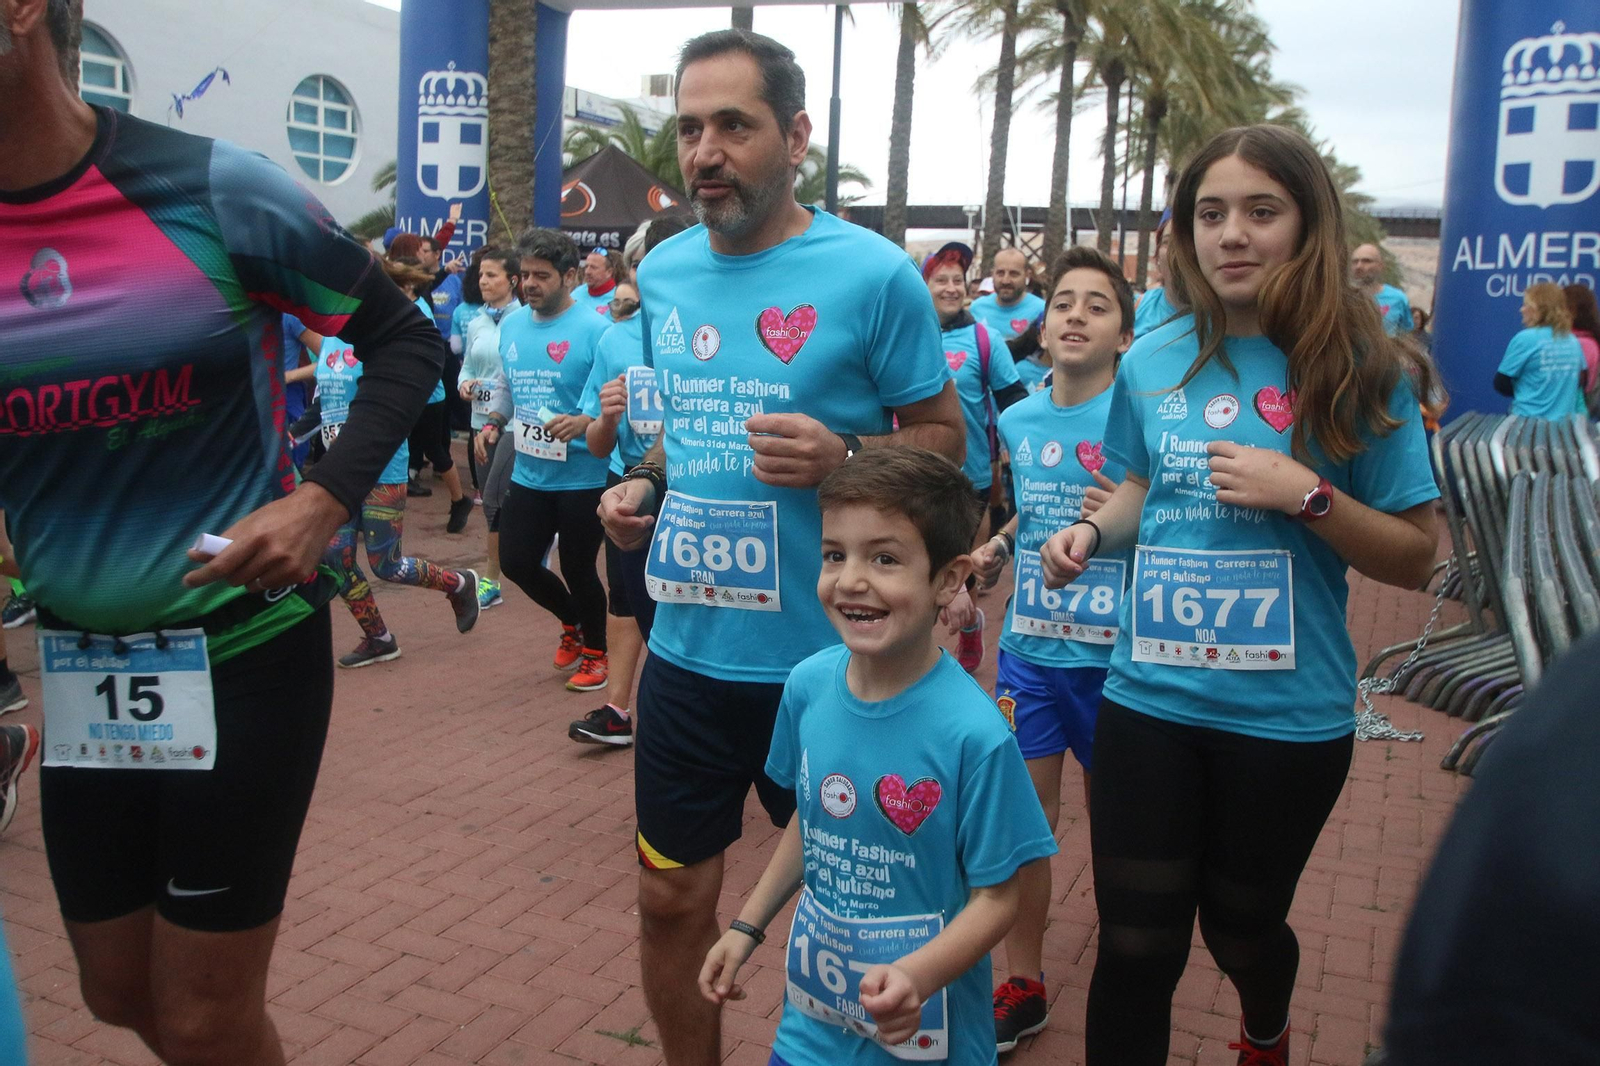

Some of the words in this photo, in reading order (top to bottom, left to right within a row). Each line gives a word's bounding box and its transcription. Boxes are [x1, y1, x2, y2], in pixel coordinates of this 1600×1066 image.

[656, 333, 685, 347] ALTEA
[663, 369, 670, 395] I
[672, 374, 725, 394] Runner
[730, 376, 790, 400] Fashion
[671, 396, 730, 414] Carrera
[1156, 403, 1187, 414] ALTEA
[522, 422, 556, 443] 739
[673, 417, 690, 432] por
[693, 416, 707, 434] el
[711, 416, 750, 436] autis
[1159, 431, 1169, 453] I
[687, 452, 721, 478] nada
[720, 450, 740, 472] te
[1163, 453, 1210, 470] Carre
[1024, 478, 1058, 492] Runner
[1060, 481, 1085, 496] Fashi
[1162, 472, 1182, 484] por
[1186, 471, 1200, 487] el
[1021, 490, 1061, 504] Carrera
[1063, 496, 1083, 507] azul
[708, 507, 745, 519] Carrera
[747, 510, 765, 520] azul
[1034, 504, 1046, 516] el
[1048, 505, 1082, 519] autism
[1155, 508, 1183, 524] Que
[1184, 501, 1212, 522] nada
[1211, 502, 1230, 519] te
[1233, 507, 1269, 523] pare
[657, 526, 767, 574] 1680
[1150, 555, 1177, 566] Runner
[1178, 557, 1208, 569] Fashion
[1214, 559, 1256, 568] Carrera
[1259, 558, 1278, 569] azul
[690, 569, 715, 584] FRAN
[1143, 570, 1158, 579] por
[1160, 570, 1171, 580] el
[1173, 570, 1211, 584] autismo
[1022, 577, 1115, 615] 1678
[1143, 583, 1280, 628] 1677
[1195, 628, 1217, 643] NOA
[95, 674, 165, 722] 15
[88, 722, 103, 740] NO
[103, 723, 136, 740] TENGO
[137, 723, 174, 741] MIEDO
[851, 838, 916, 868] Fashion
[855, 864, 891, 883] azul
[818, 867, 833, 887] el
[835, 876, 896, 900] autismo
[849, 899, 879, 910] Marzo
[819, 915, 850, 938] Fashion
[858, 928, 906, 940] Carrera
[908, 924, 930, 938] azul
[807, 922, 816, 938] el
[815, 930, 854, 953] autismo
[836, 995, 866, 1021] FABIO
